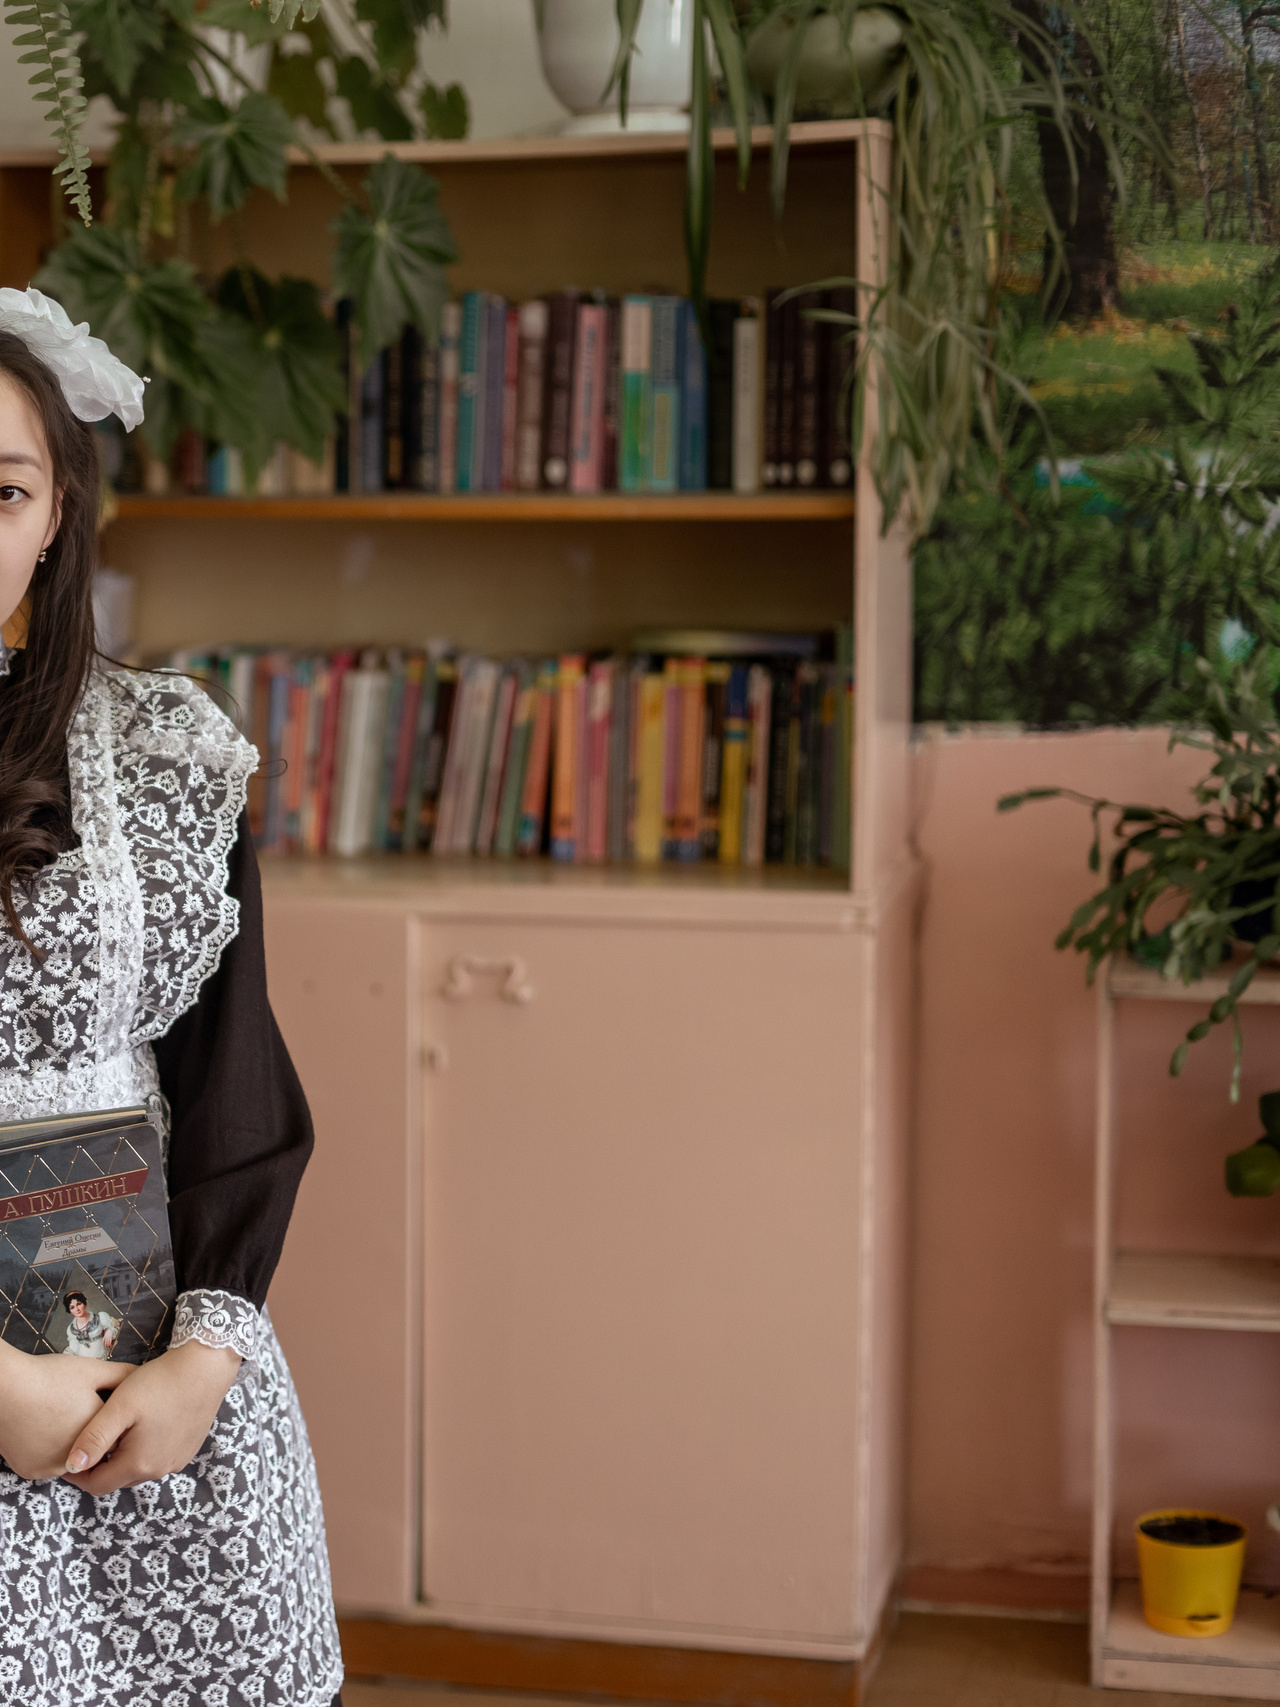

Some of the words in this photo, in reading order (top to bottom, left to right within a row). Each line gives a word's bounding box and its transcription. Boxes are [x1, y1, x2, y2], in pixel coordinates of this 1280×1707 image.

[4, 1201, 24, 1219] А.
[28, 1176, 128, 1214] ПУШКИН
[44, 1237, 74, 1249] Евгений
[74, 1231, 102, 1243] Онегин
[61, 1246, 87, 1258] Драмы
